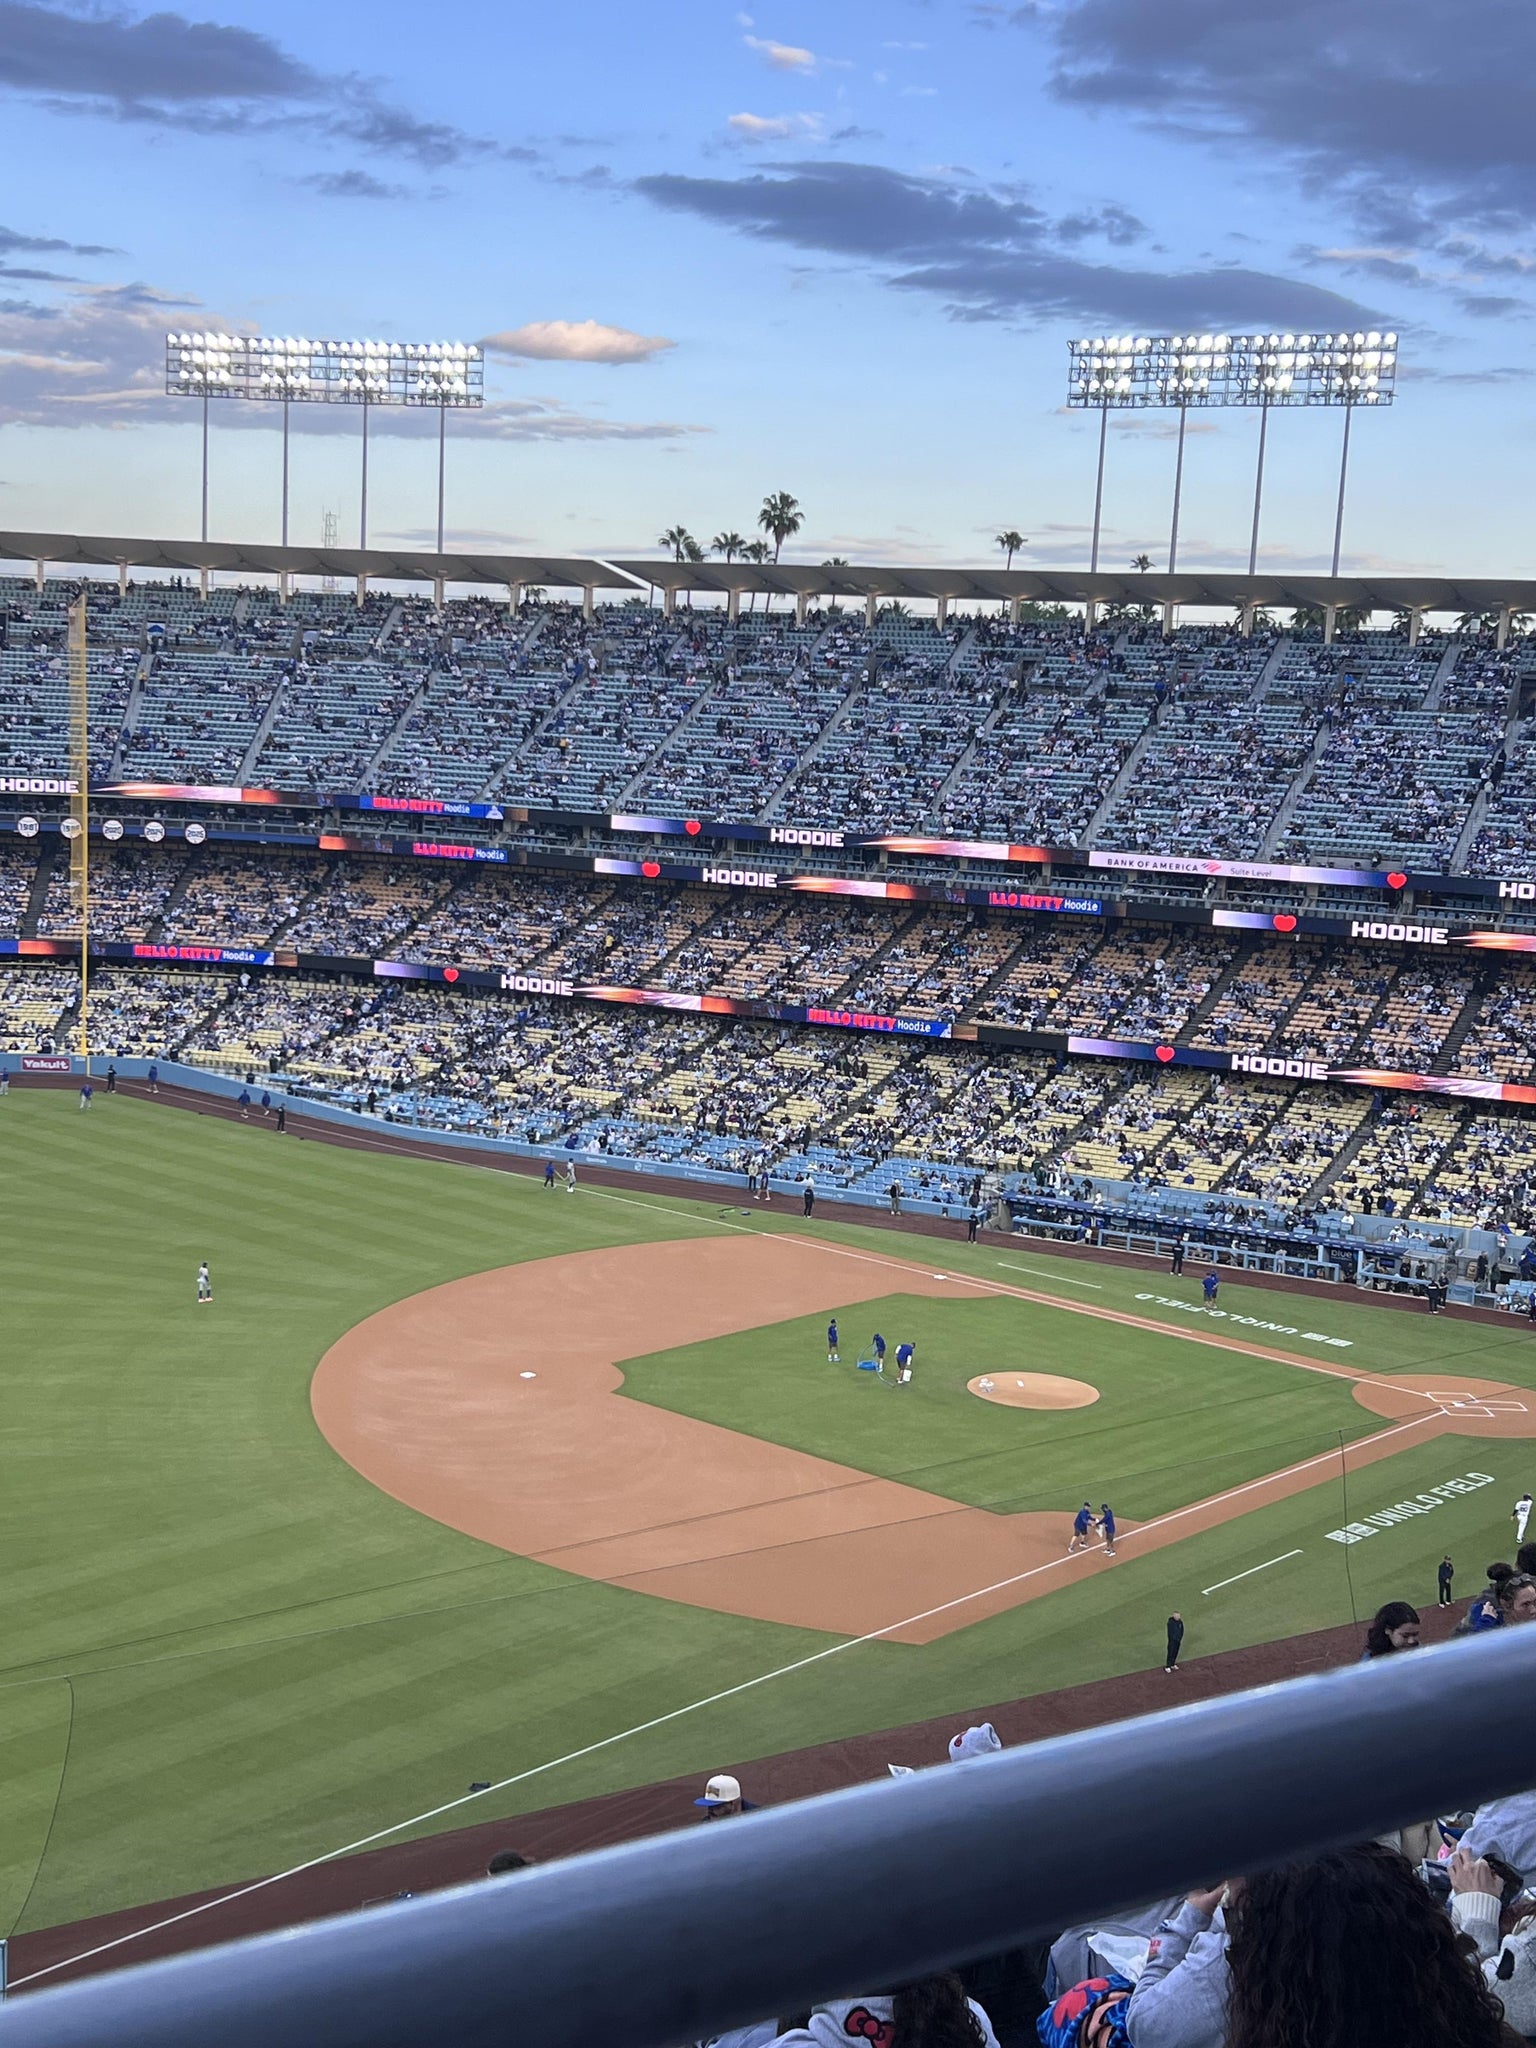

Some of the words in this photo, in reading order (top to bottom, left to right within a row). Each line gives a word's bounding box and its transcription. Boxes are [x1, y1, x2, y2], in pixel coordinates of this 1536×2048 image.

[0, 778, 79, 794] HOODIE
[409, 798, 444, 812] KITTY
[444, 803, 471, 814] Hoodie
[770, 828, 845, 847] HOODIE
[412, 842, 438, 855] LLO
[439, 844, 475, 859] KITTY
[475, 848, 505, 860] Hoodie
[1107, 858, 1136, 868] BANK
[1137, 860, 1150, 868] OF
[1152, 861, 1199, 872] AMERICA
[1230, 867, 1250, 876] Suite
[1251, 869, 1273, 878] Level
[702, 868, 778, 888] HOODIE
[989, 892, 1018, 906] LLO
[1019, 894, 1064, 909] KITTY
[1064, 898, 1099, 912] Hoodie
[1351, 920, 1449, 945] HOODIE
[134, 945, 178, 957] HELLO
[179, 947, 222, 961] KITTY
[222, 950, 255, 961] Hoodie
[500, 974, 574, 996] HOODIE
[852, 1014, 896, 1031] KITTY
[897, 1020, 931, 1032] Hoodie
[23, 1059, 69, 1070] Yakult
[1231, 1054, 1329, 1080] HOODIE
[1134, 1293, 1205, 1312] FIELD
[1209, 1309, 1298, 1334] UNIQLO
[1363, 1494, 1444, 1527] UNIQLO
[1428, 1472, 1496, 1499] FIELD
